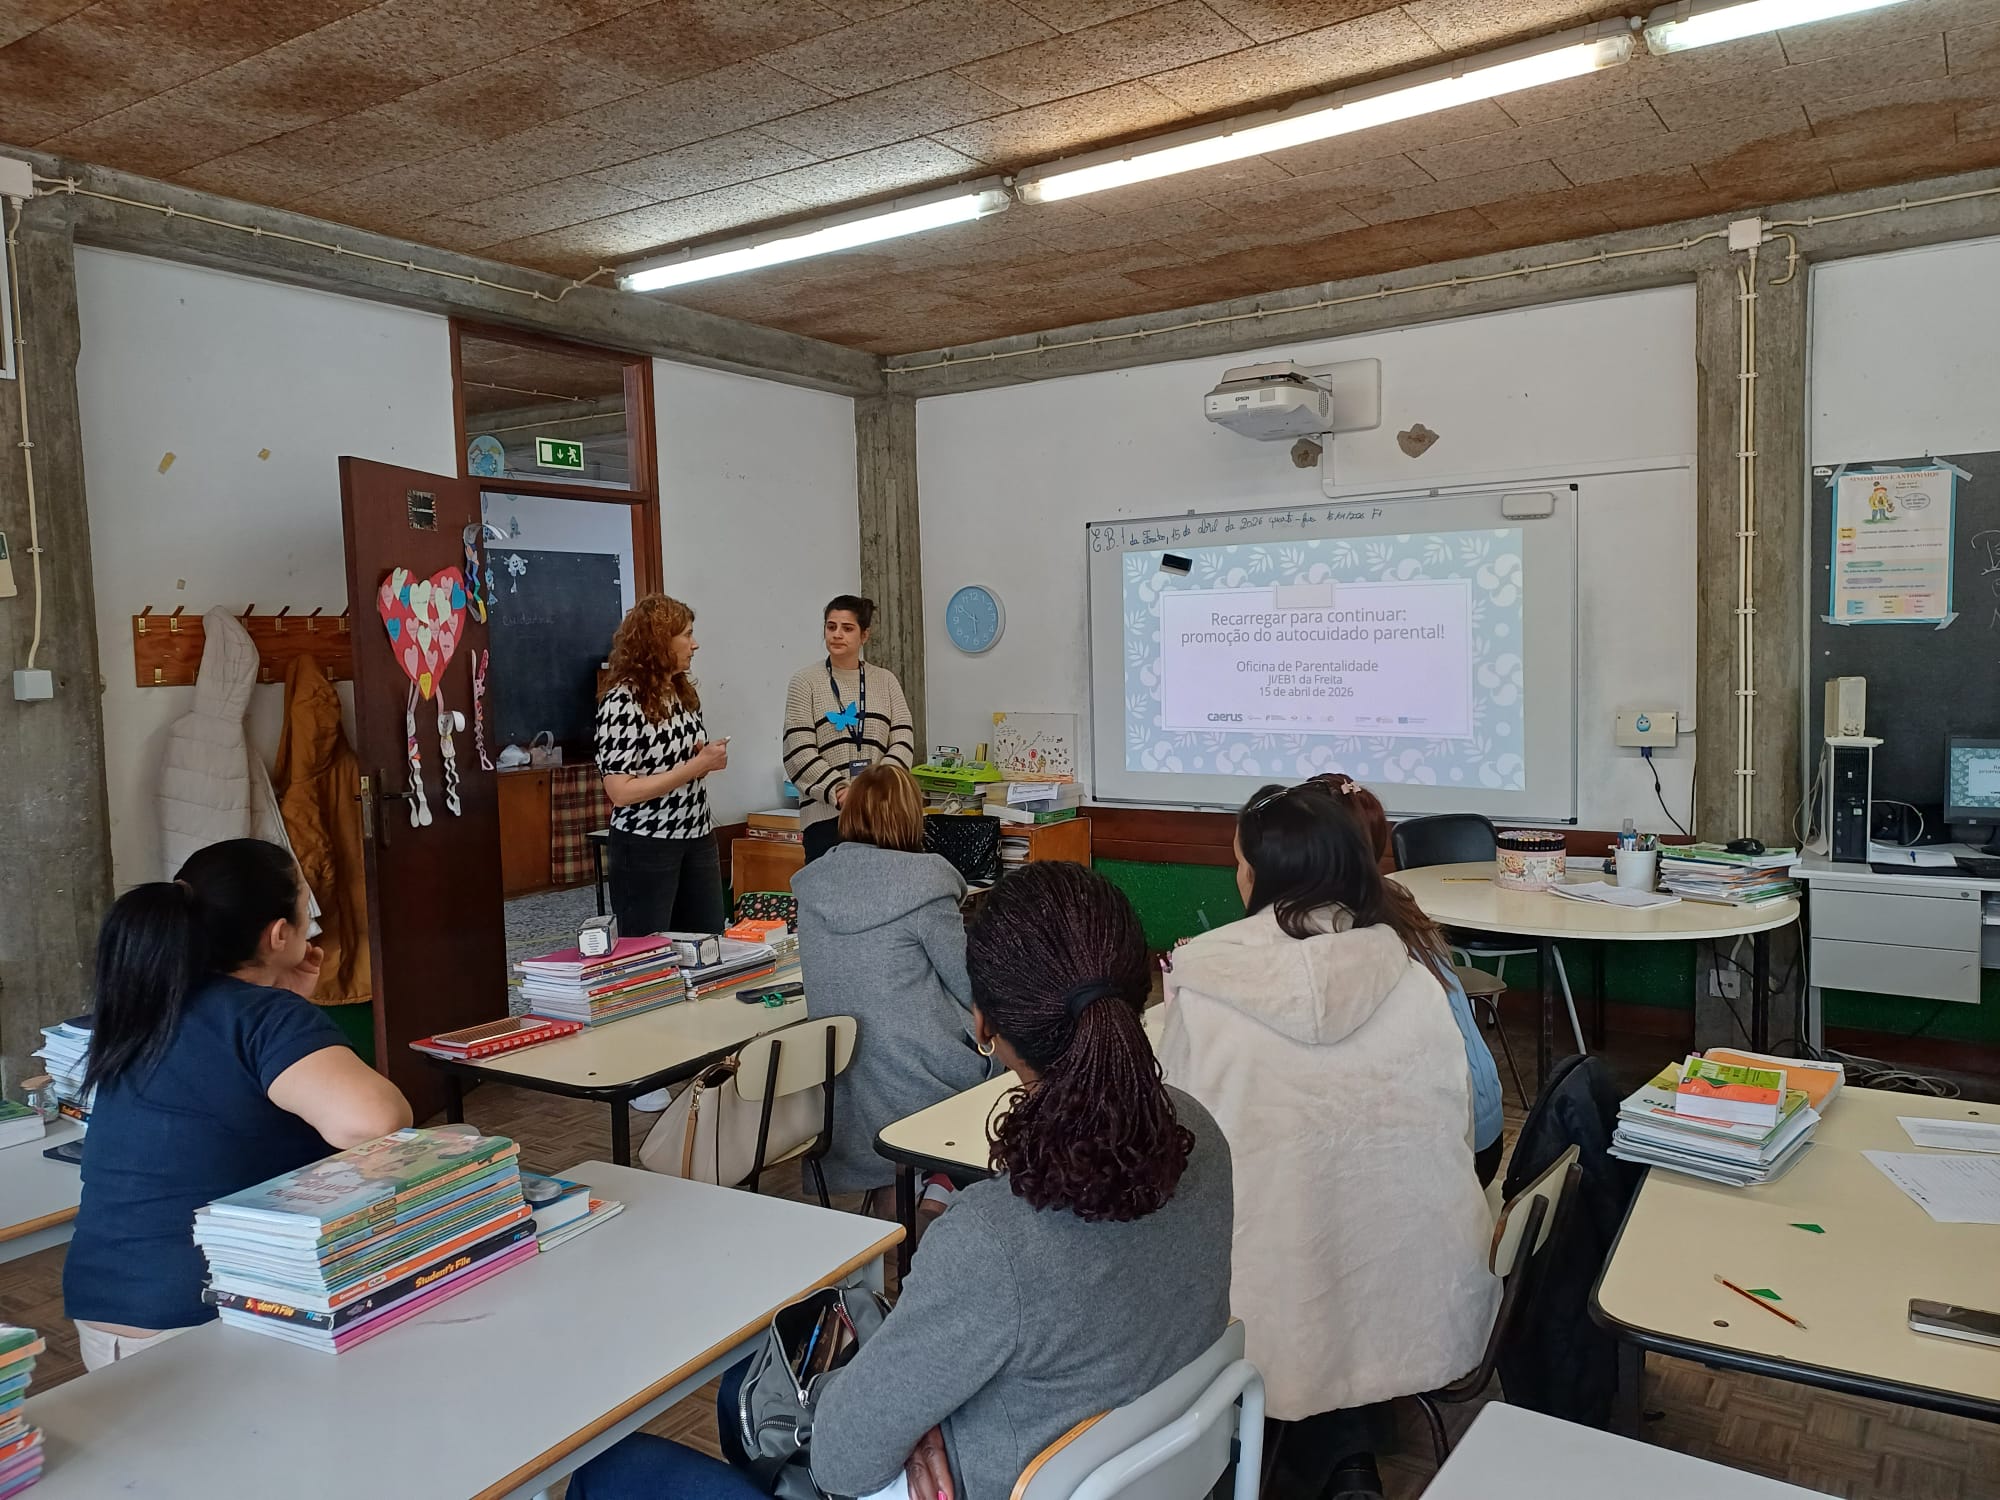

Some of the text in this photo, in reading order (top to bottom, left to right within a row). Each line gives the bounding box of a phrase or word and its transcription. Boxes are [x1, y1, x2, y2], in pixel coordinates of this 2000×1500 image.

[1171, 528, 1180, 541] 15
[1240, 516, 1262, 530] 2026
[1211, 608, 1407, 628] Recarregar para continuar:
[1181, 624, 1445, 646] promoção do autocuidado parental!
[1236, 660, 1378, 672] Oficina de Parentalidade
[1268, 674, 1342, 686] JI/EB1 da Freita
[1260, 686, 1354, 697] 15 de abril de 2026
[1207, 712, 1244, 722] caerus
[414, 1264, 455, 1288] Student's
[455, 1256, 471, 1270] File
[245, 1298, 280, 1314] Sdent's
[280, 1304, 294, 1317] File
